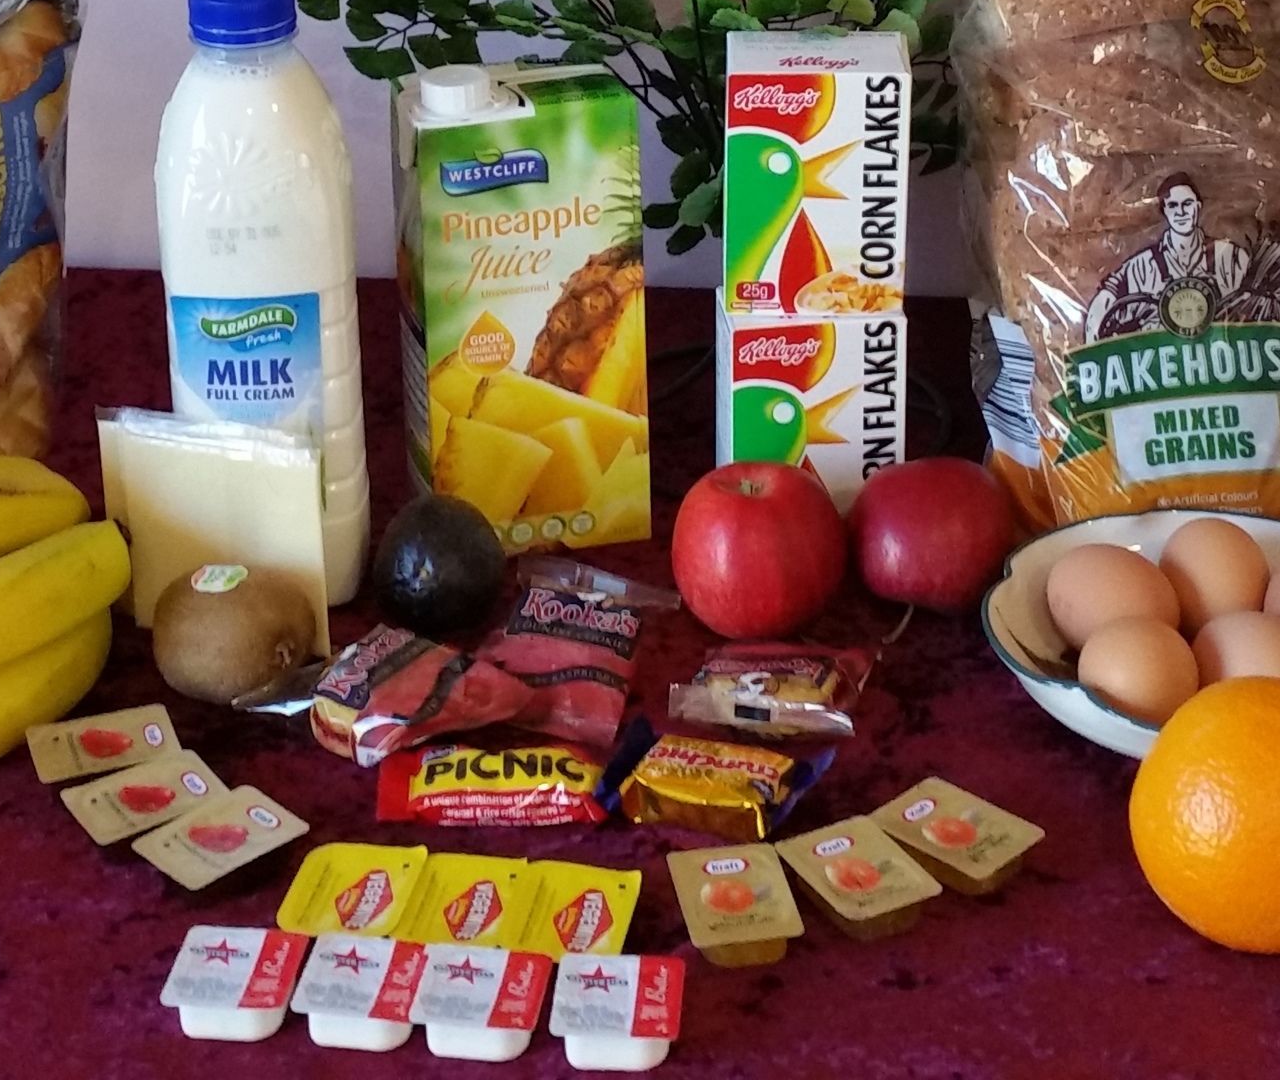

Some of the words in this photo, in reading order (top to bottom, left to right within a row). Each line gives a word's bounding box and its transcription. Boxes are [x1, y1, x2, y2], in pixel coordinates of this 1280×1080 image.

[779, 55, 860, 69] Kellogg's
[735, 83, 821, 112] Kellogg's
[865, 75, 902, 189] FLAKES
[448, 161, 536, 183] WESTCLIFF
[443, 197, 601, 243] Pineapple
[860, 196, 897, 280] CORN
[443, 244, 552, 305] Juice
[480, 281, 550, 299] Unsweetened
[742, 283, 768, 299] 25g
[211, 308, 283, 337] FARMDALE
[465, 344, 498, 356] SOURCE
[469, 332, 505, 347] GOOD
[739, 333, 821, 364] Kellogg's
[207, 357, 294, 386] MILK
[864, 320, 897, 433] FLAKES
[206, 388, 239, 401] FULL
[243, 386, 295, 401] CREAM
[1153, 404, 1240, 434] MIXED
[1144, 430, 1257, 468] GRAINS
[1173, 493, 1218, 506] Artificial
[1220, 489, 1259, 503] Colours
[424, 751, 586, 786] PICNIC
[461, 793, 513, 806] combination
[820, 838, 850, 855] Kraft
[709, 859, 740, 874] Kraft
